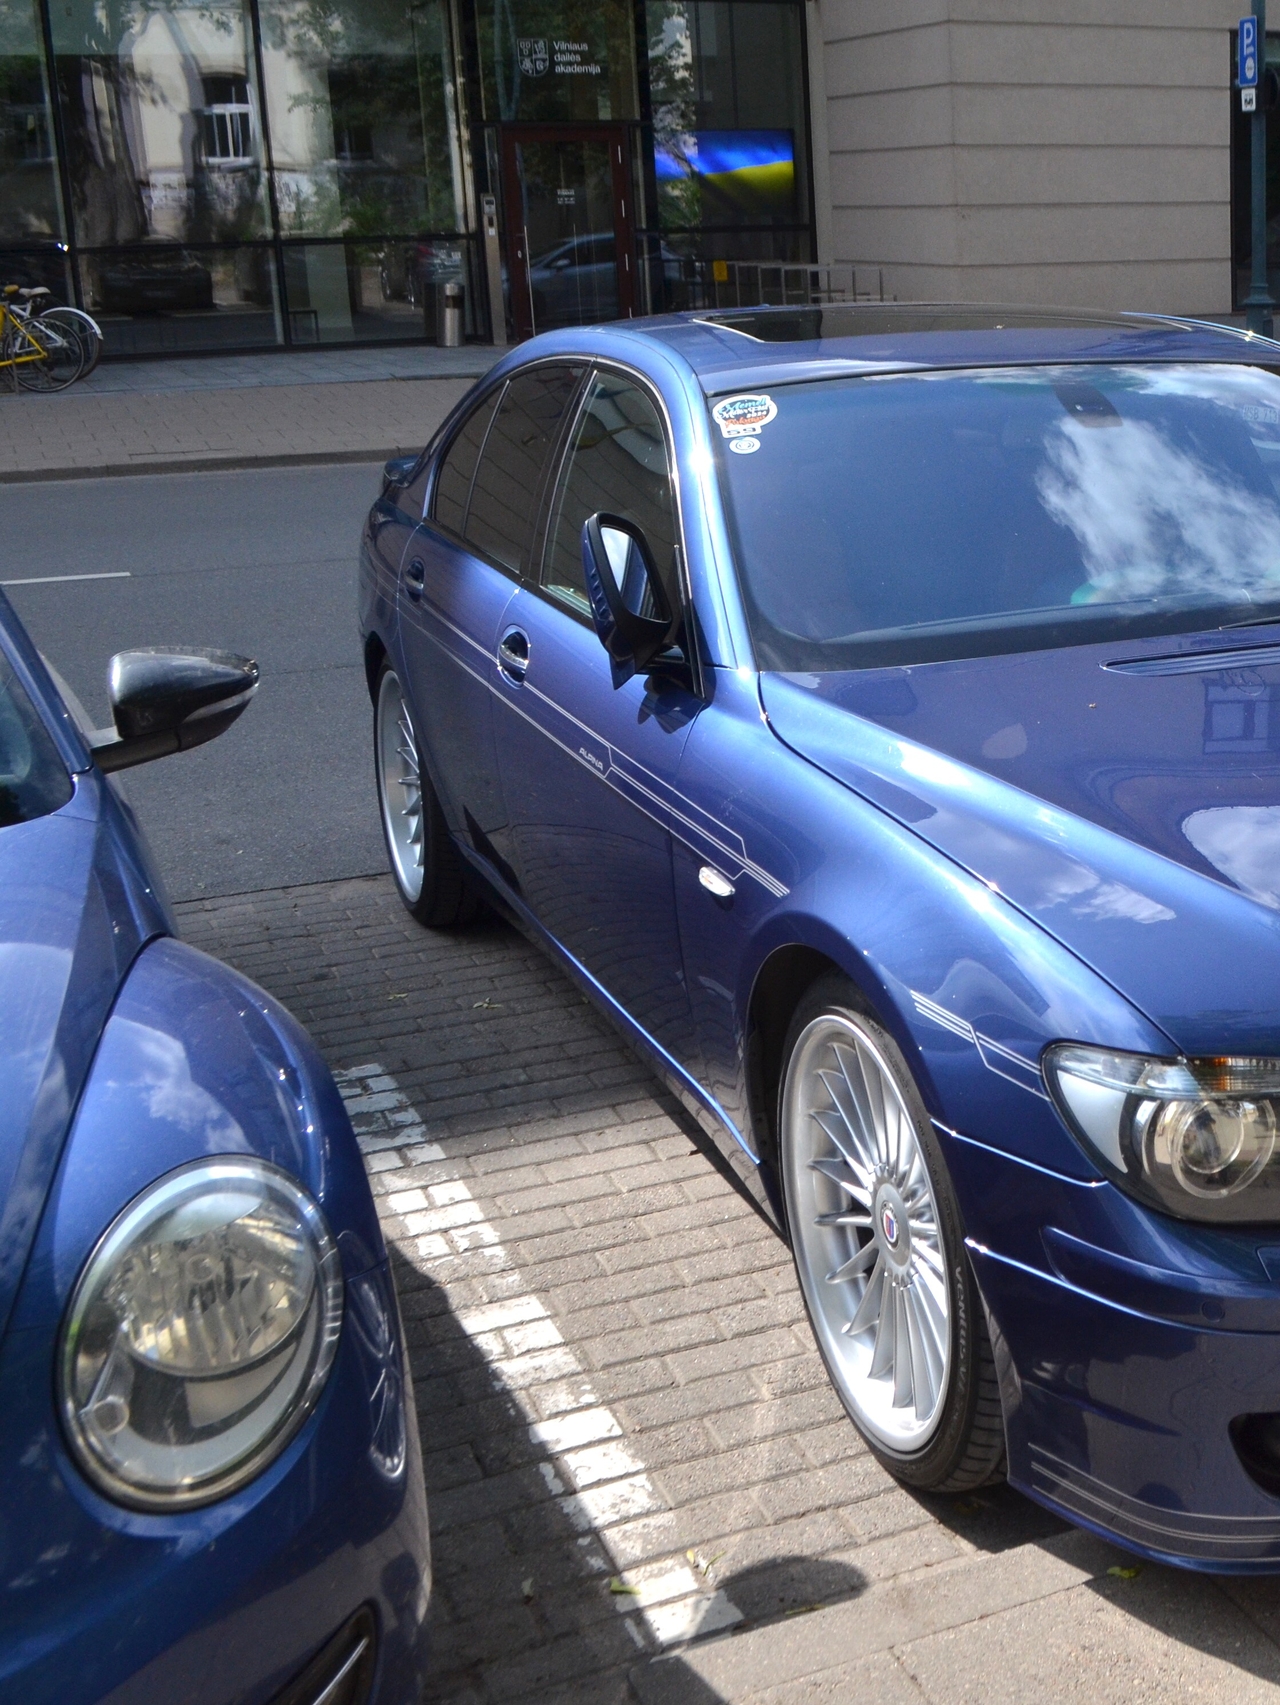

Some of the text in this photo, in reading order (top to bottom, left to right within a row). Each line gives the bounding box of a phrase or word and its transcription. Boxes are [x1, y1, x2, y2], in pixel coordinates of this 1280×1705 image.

[553, 41, 588, 50] Vilniaus
[1243, 22, 1254, 56] P
[555, 63, 601, 75] akademija
[579, 747, 603, 771] ALPINA
